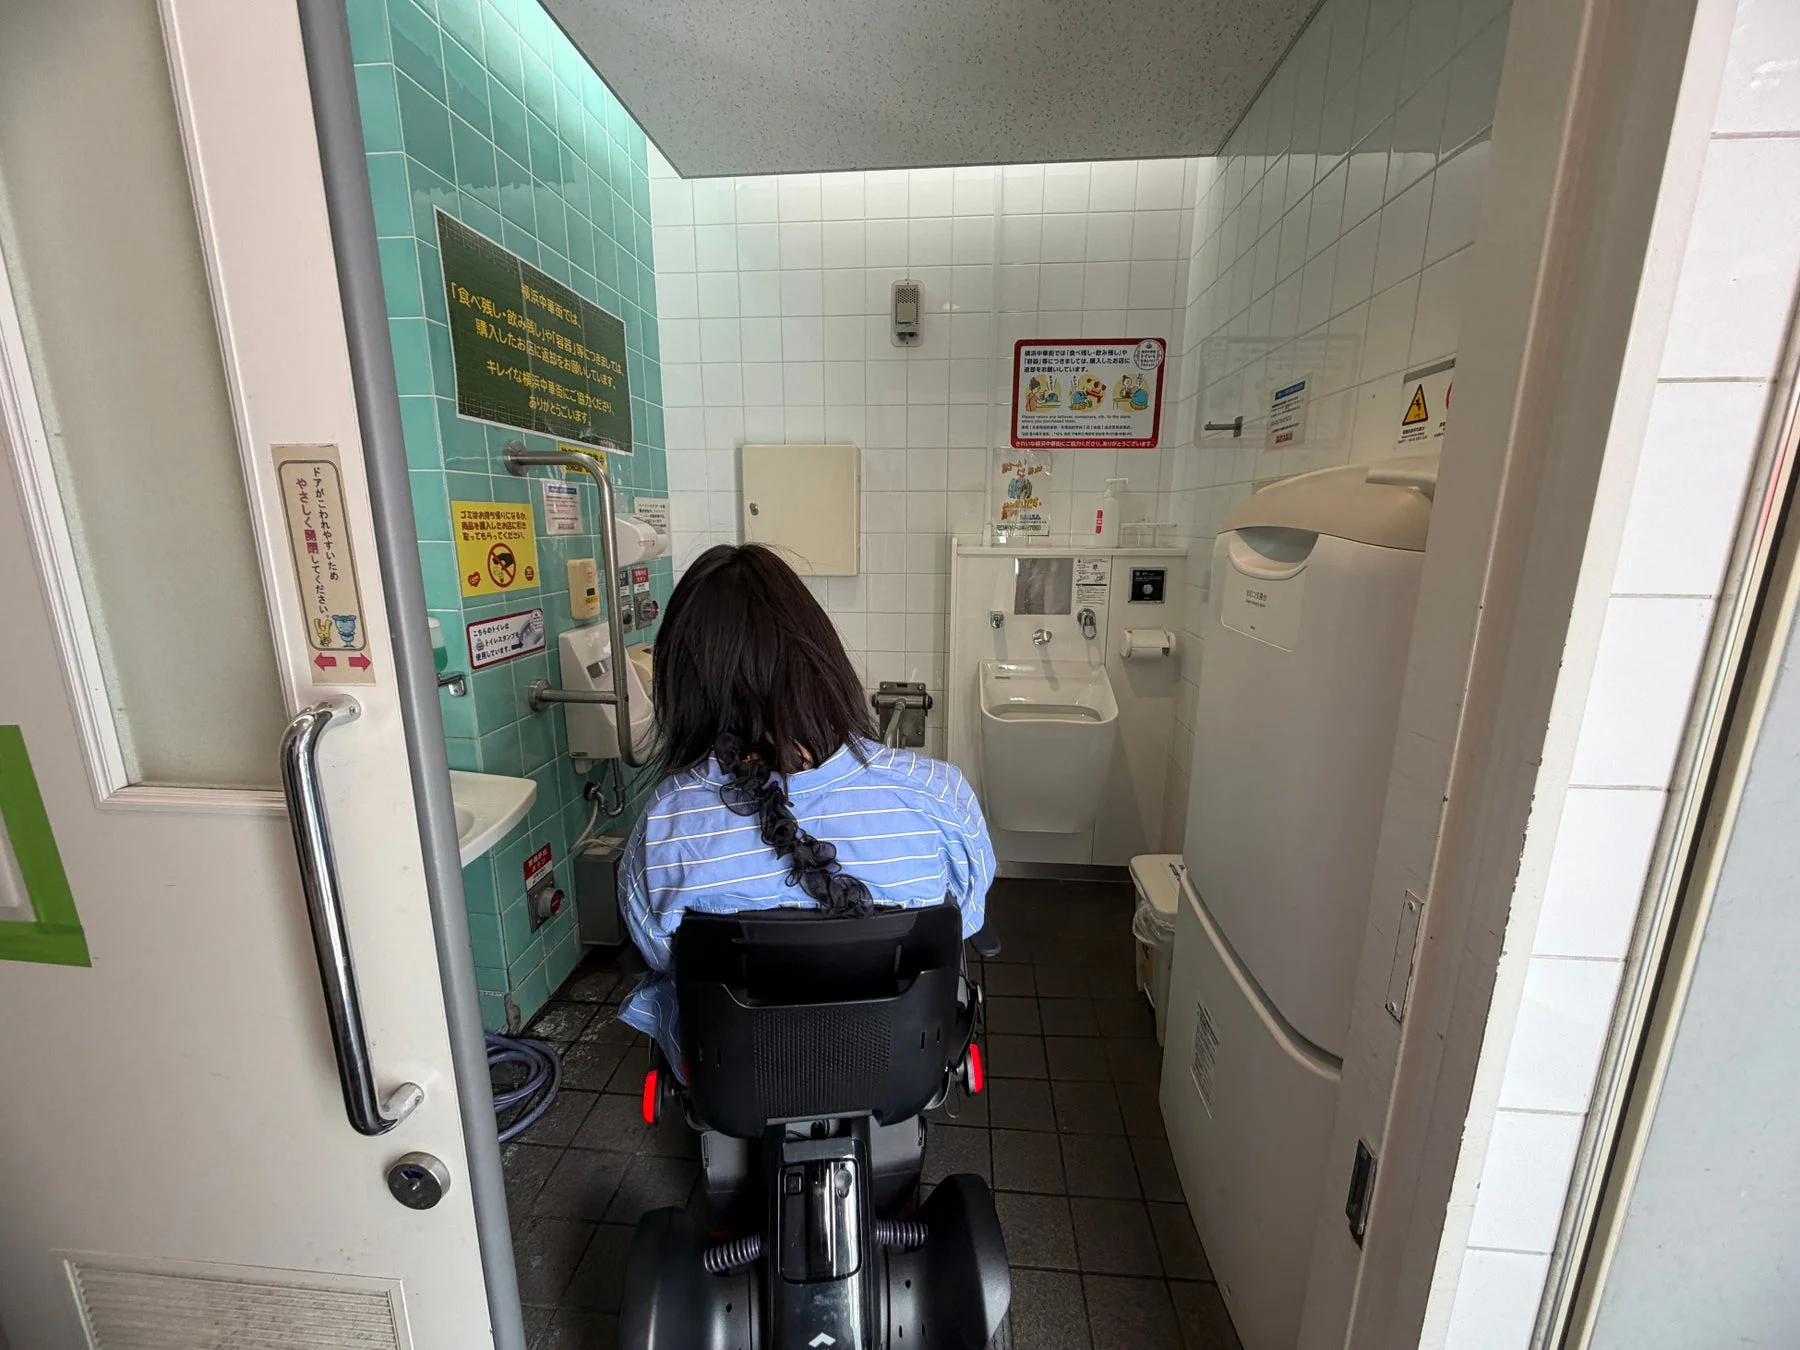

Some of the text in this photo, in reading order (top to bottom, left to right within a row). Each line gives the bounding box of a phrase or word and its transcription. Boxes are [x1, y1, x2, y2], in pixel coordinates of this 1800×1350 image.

[521, 285, 582, 330] 横浜中華街では、
[475, 317, 617, 390] 購入したお店に返却をお願いしています。
[486, 360, 615, 415] キレイな横浜中華街にご協力くださり、
[528, 395, 592, 427] ありがとうございます。
[295, 477, 330, 619] やさしく開閉してください。
[312, 466, 339, 581] ドアがこわれやすいため
[472, 623, 510, 637] こちらのトイレは
[475, 645, 512, 662] 使用しています。
